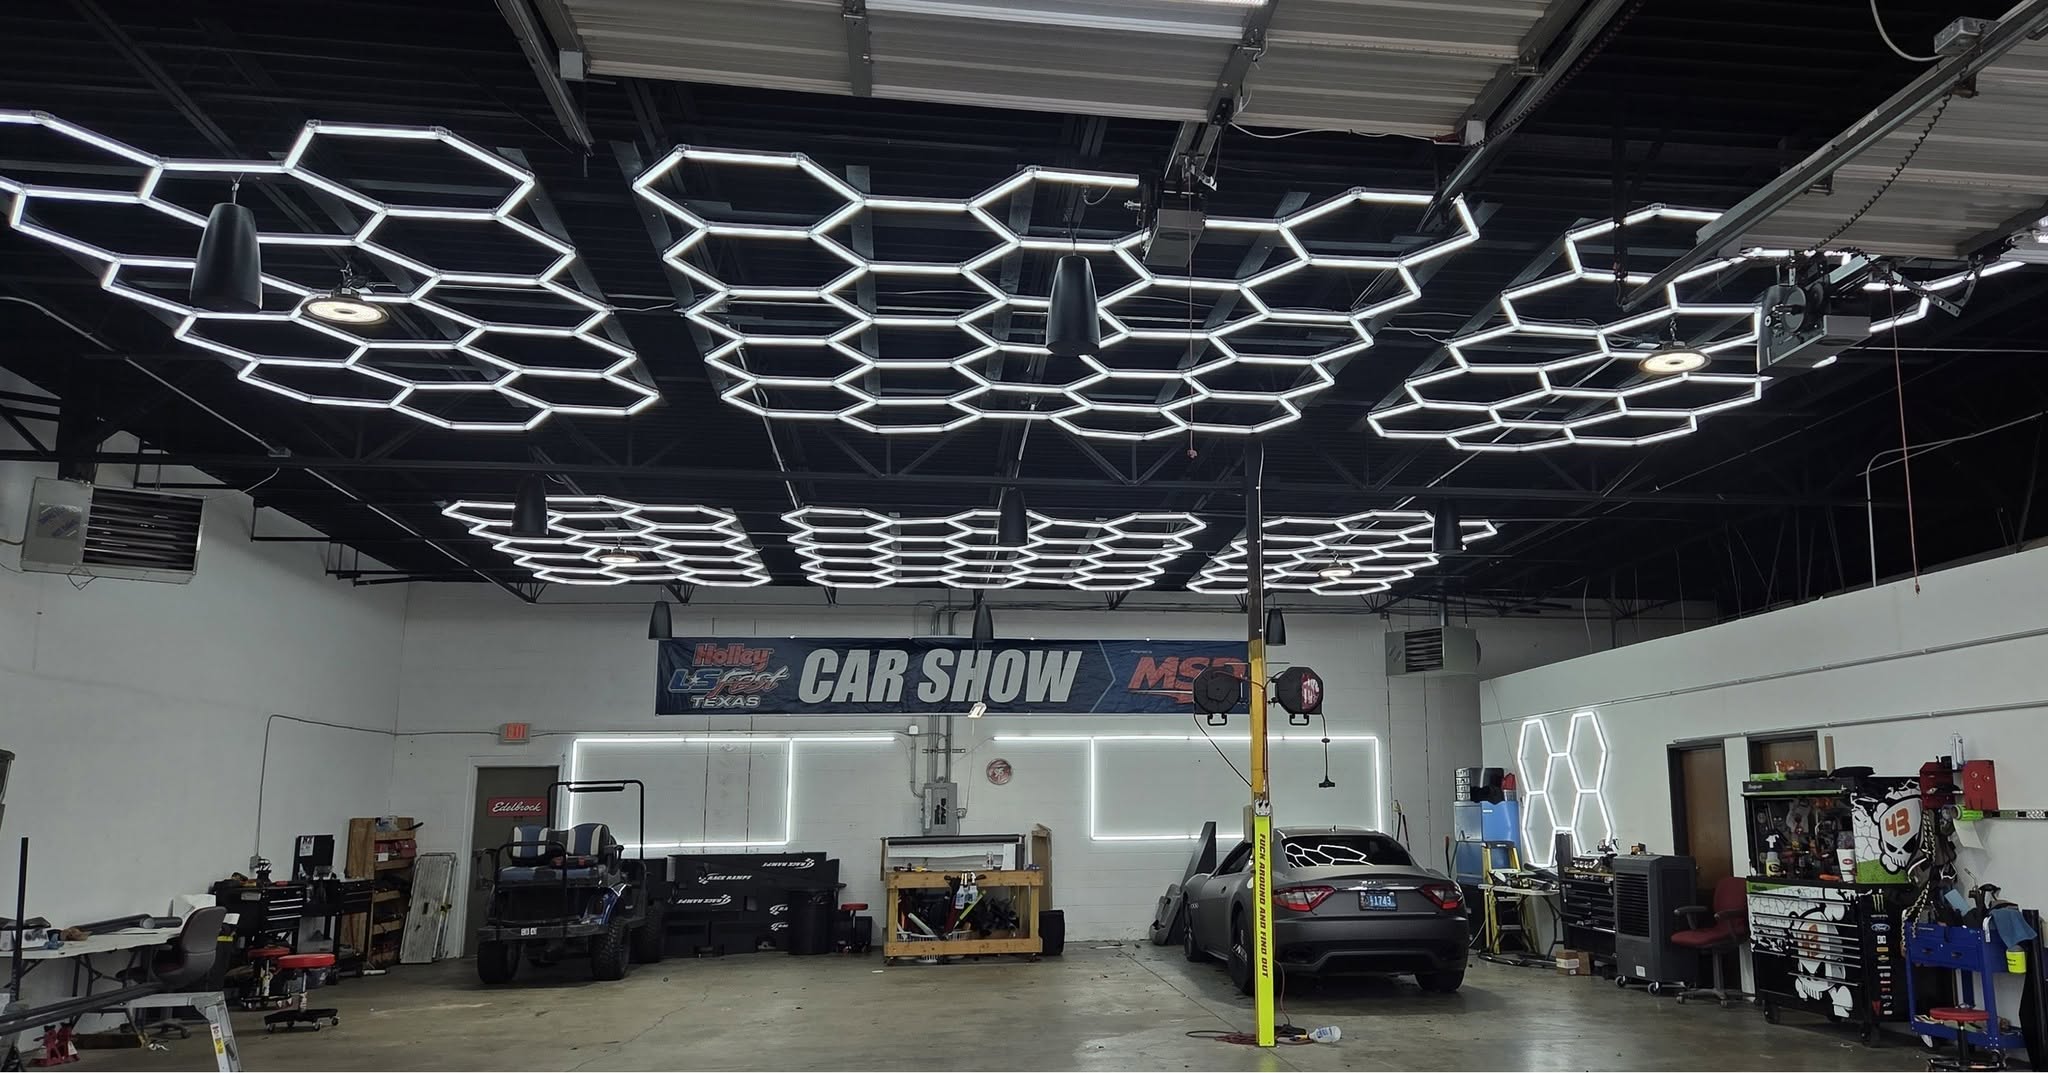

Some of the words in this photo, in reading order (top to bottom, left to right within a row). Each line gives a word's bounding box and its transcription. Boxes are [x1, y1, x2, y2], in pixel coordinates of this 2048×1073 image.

[692, 643, 774, 672] Holley
[668, 668, 723, 693] LS
[799, 649, 909, 703] CAR
[918, 649, 1082, 703] SHOW
[691, 695, 760, 708] TEXAS
[506, 723, 527, 738] EXIT
[492, 801, 541, 812] Edelbrock
[1885, 808, 1910, 837] 43
